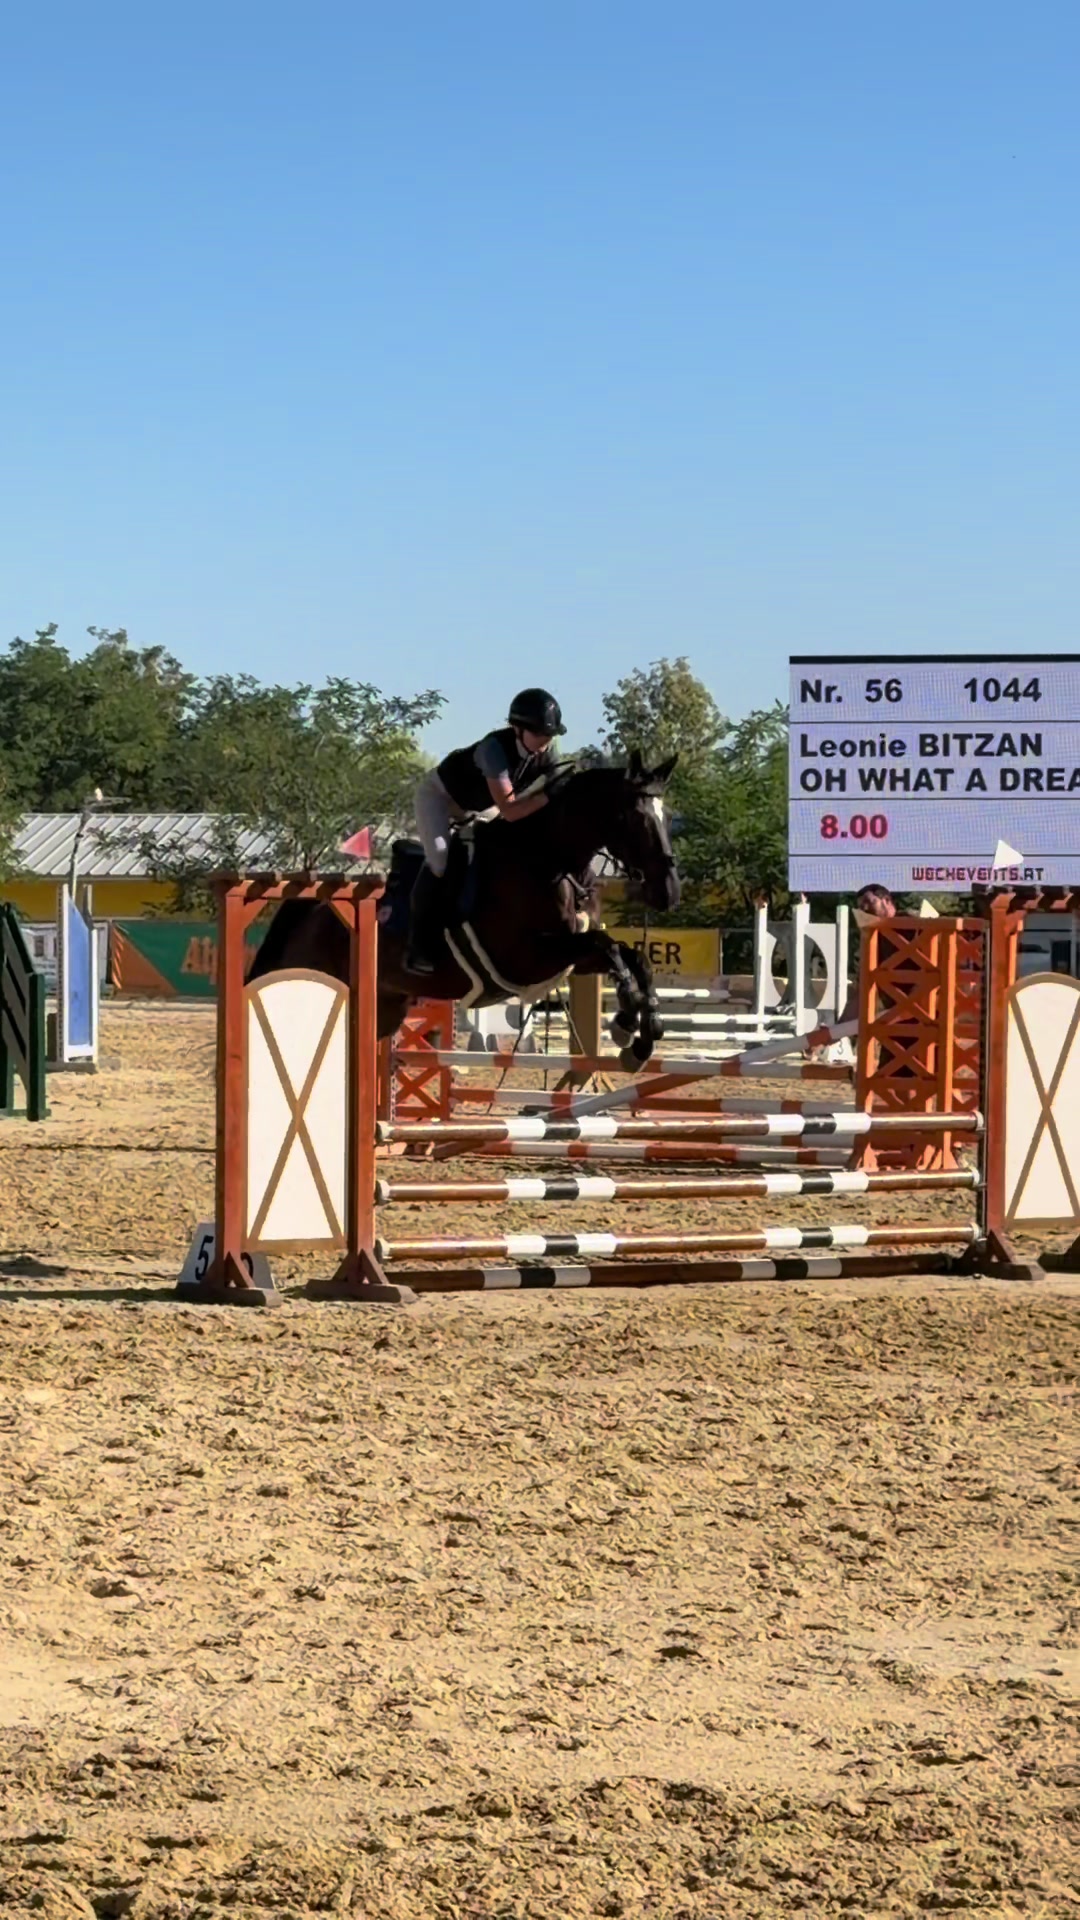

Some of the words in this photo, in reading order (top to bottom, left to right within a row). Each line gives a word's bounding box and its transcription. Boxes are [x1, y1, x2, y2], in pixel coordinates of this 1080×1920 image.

[800, 678, 843, 703] Nr.
[864, 678, 903, 703] 56
[963, 677, 1042, 703] 1044
[800, 732, 907, 758] Leonie
[918, 732, 1043, 758] BITZAN
[800, 767, 847, 792] OH
[857, 767, 955, 792] WHAT
[964, 767, 988, 792] A
[999, 767, 1080, 792] DREA
[820, 814, 888, 840] 8.00
[195, 1235, 214, 1280] 5
